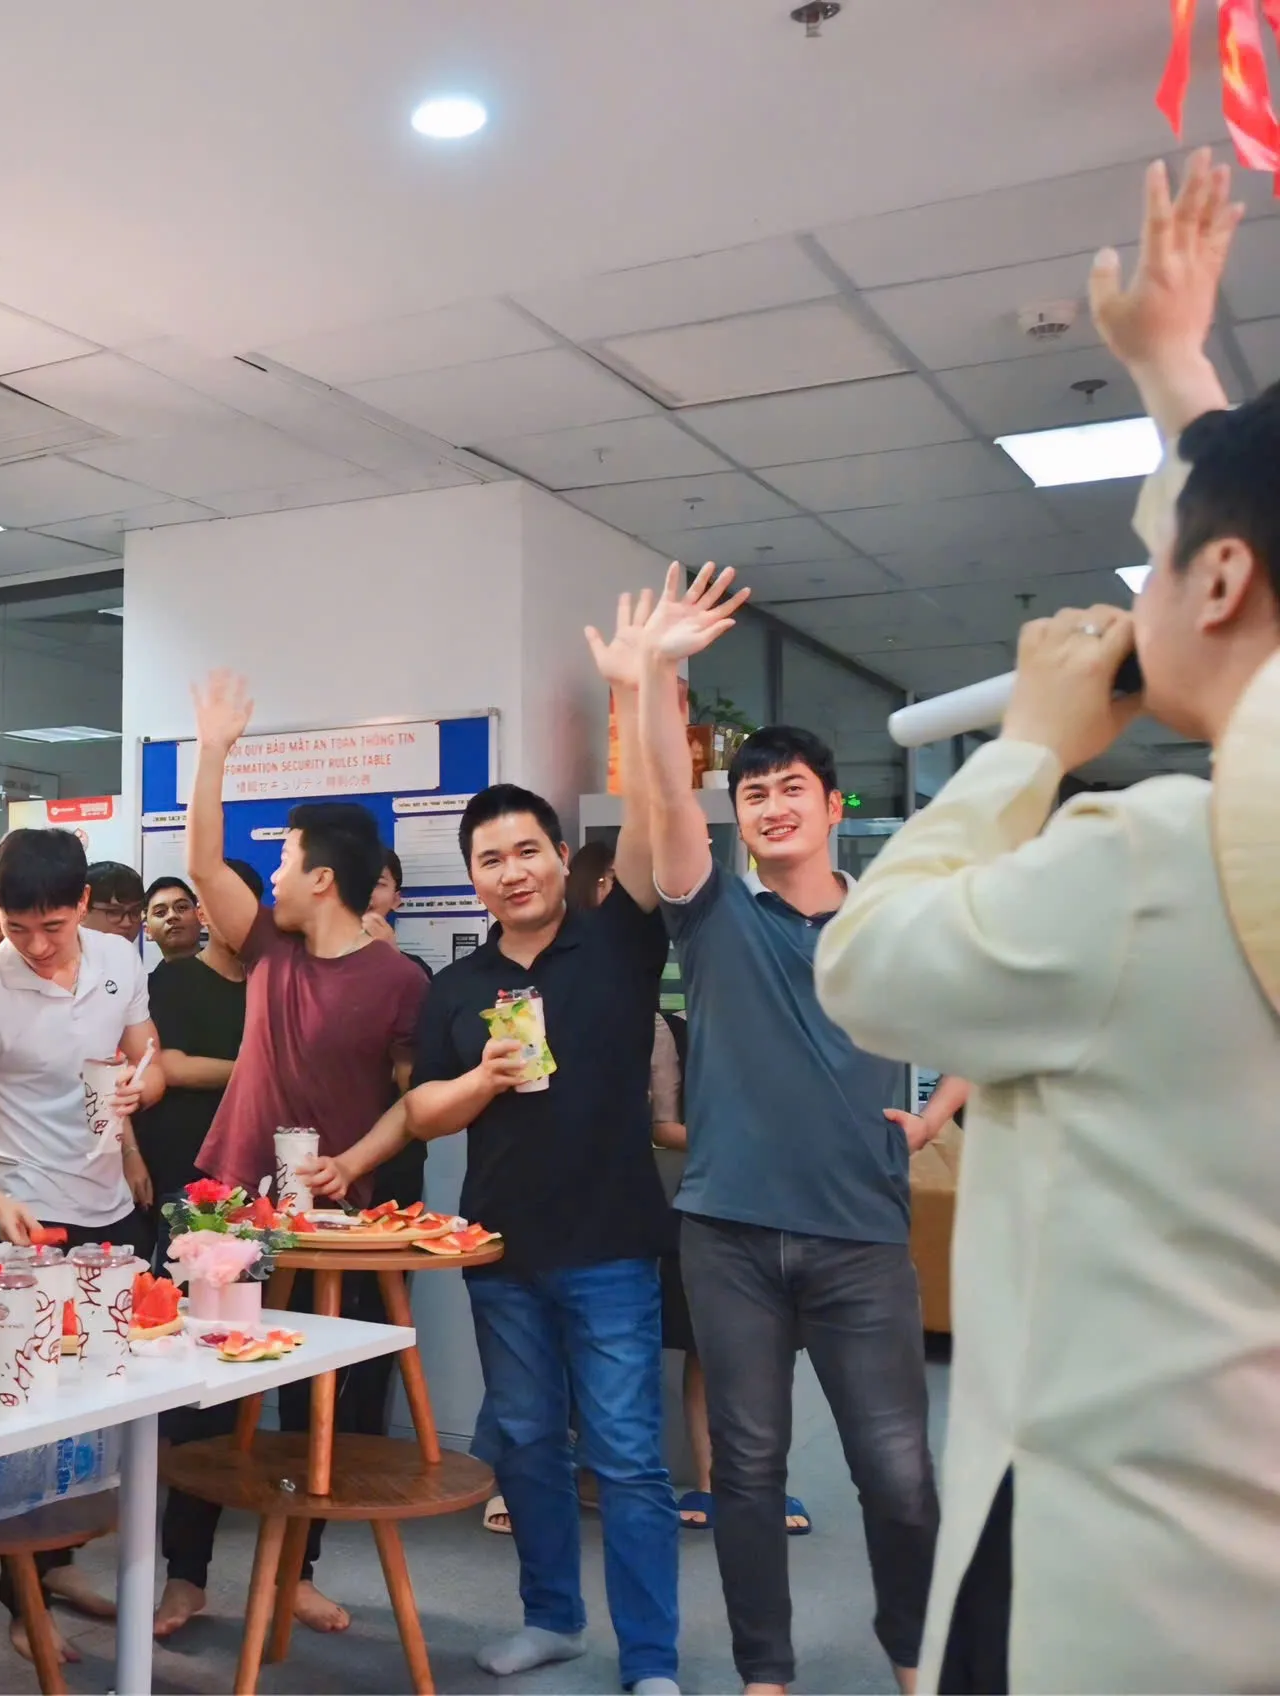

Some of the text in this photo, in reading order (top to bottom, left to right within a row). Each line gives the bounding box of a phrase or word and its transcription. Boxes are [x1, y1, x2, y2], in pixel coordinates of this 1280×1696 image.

[313, 739, 328, 751] AN
[224, 753, 392, 776] FORMATION SECURITY RULES TABLE
